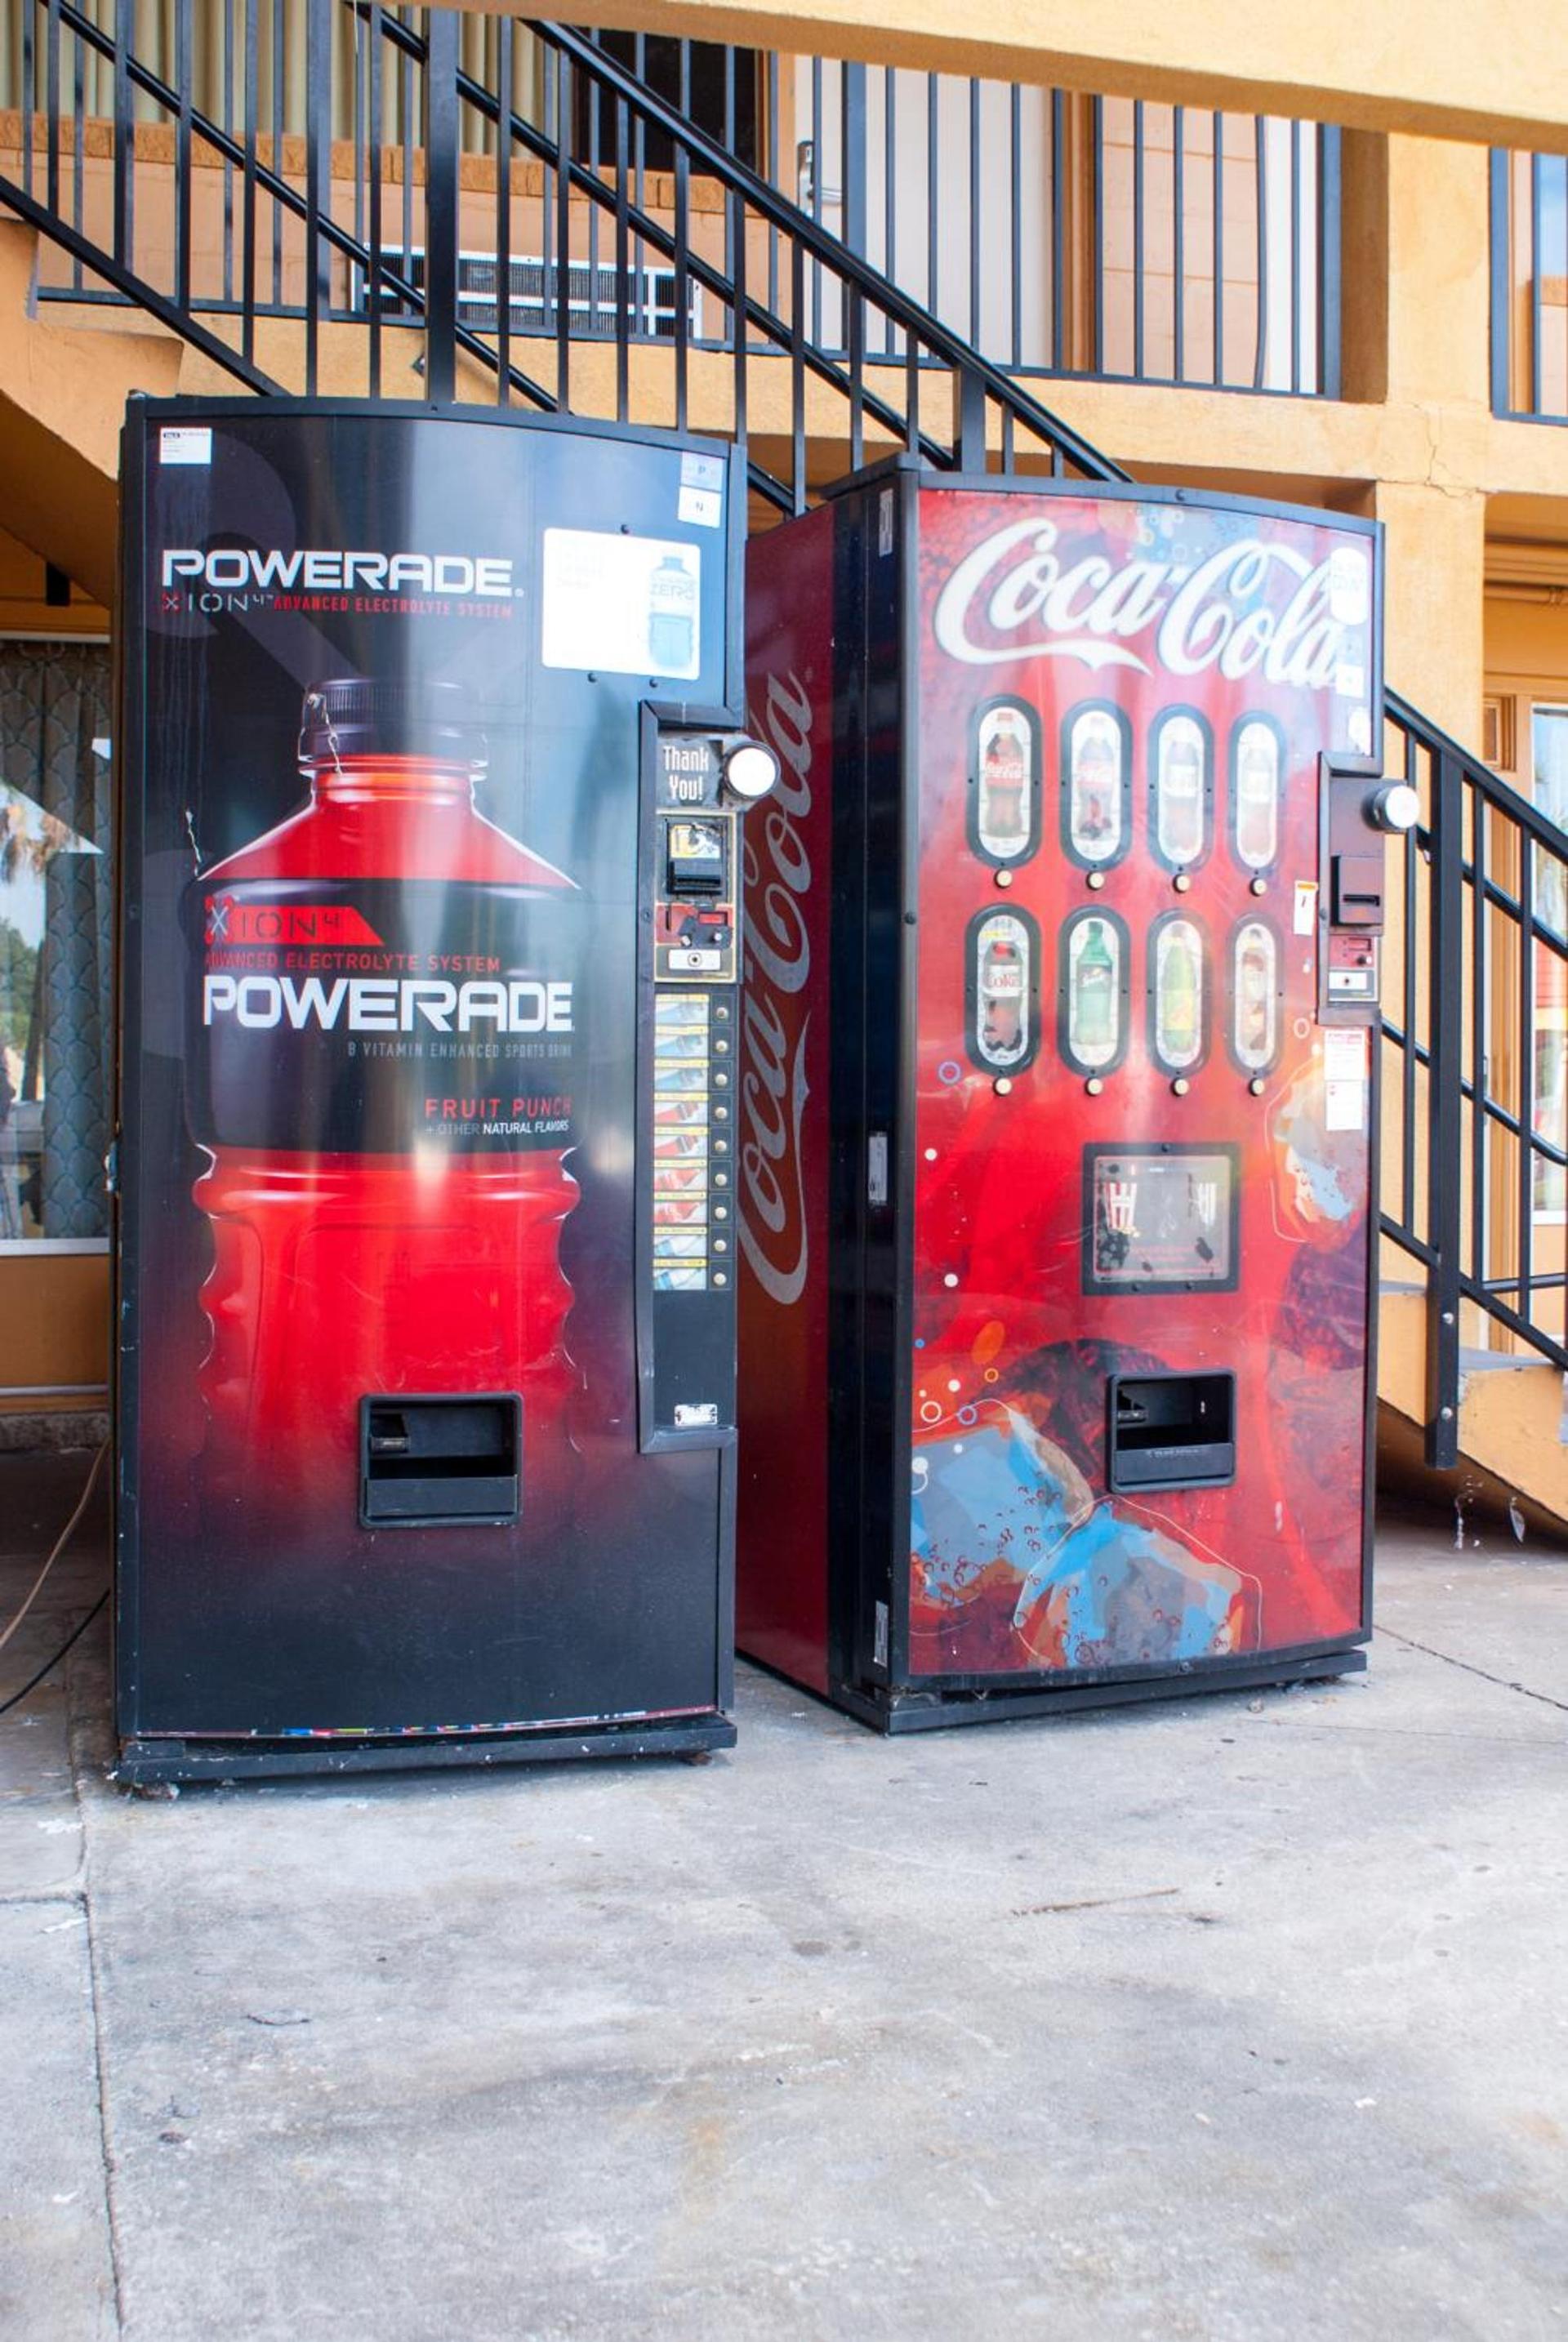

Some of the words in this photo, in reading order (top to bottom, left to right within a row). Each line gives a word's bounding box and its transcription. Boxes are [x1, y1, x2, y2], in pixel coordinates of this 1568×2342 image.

[273, 594, 350, 612] ADVANCED
[354, 597, 451, 617] ELECTROLYTE
[457, 600, 514, 621] SYSTEM
[663, 745, 709, 773] Thank
[669, 774, 703, 801] You!
[286, 953, 418, 972] ELECTROLYTE
[427, 955, 501, 973] SYSTEM
[203, 974, 573, 1034] POWERADE
[363, 1042, 423, 1058] VITAMIN
[430, 1042, 498, 1059] ENHANCED
[505, 1044, 546, 1059] SPORTS
[424, 1098, 501, 1119] FRUIT
[511, 1096, 572, 1118] PUNCH
[483, 1121, 532, 1135] NATURAL
[535, 1119, 570, 1133] FLAVORS
